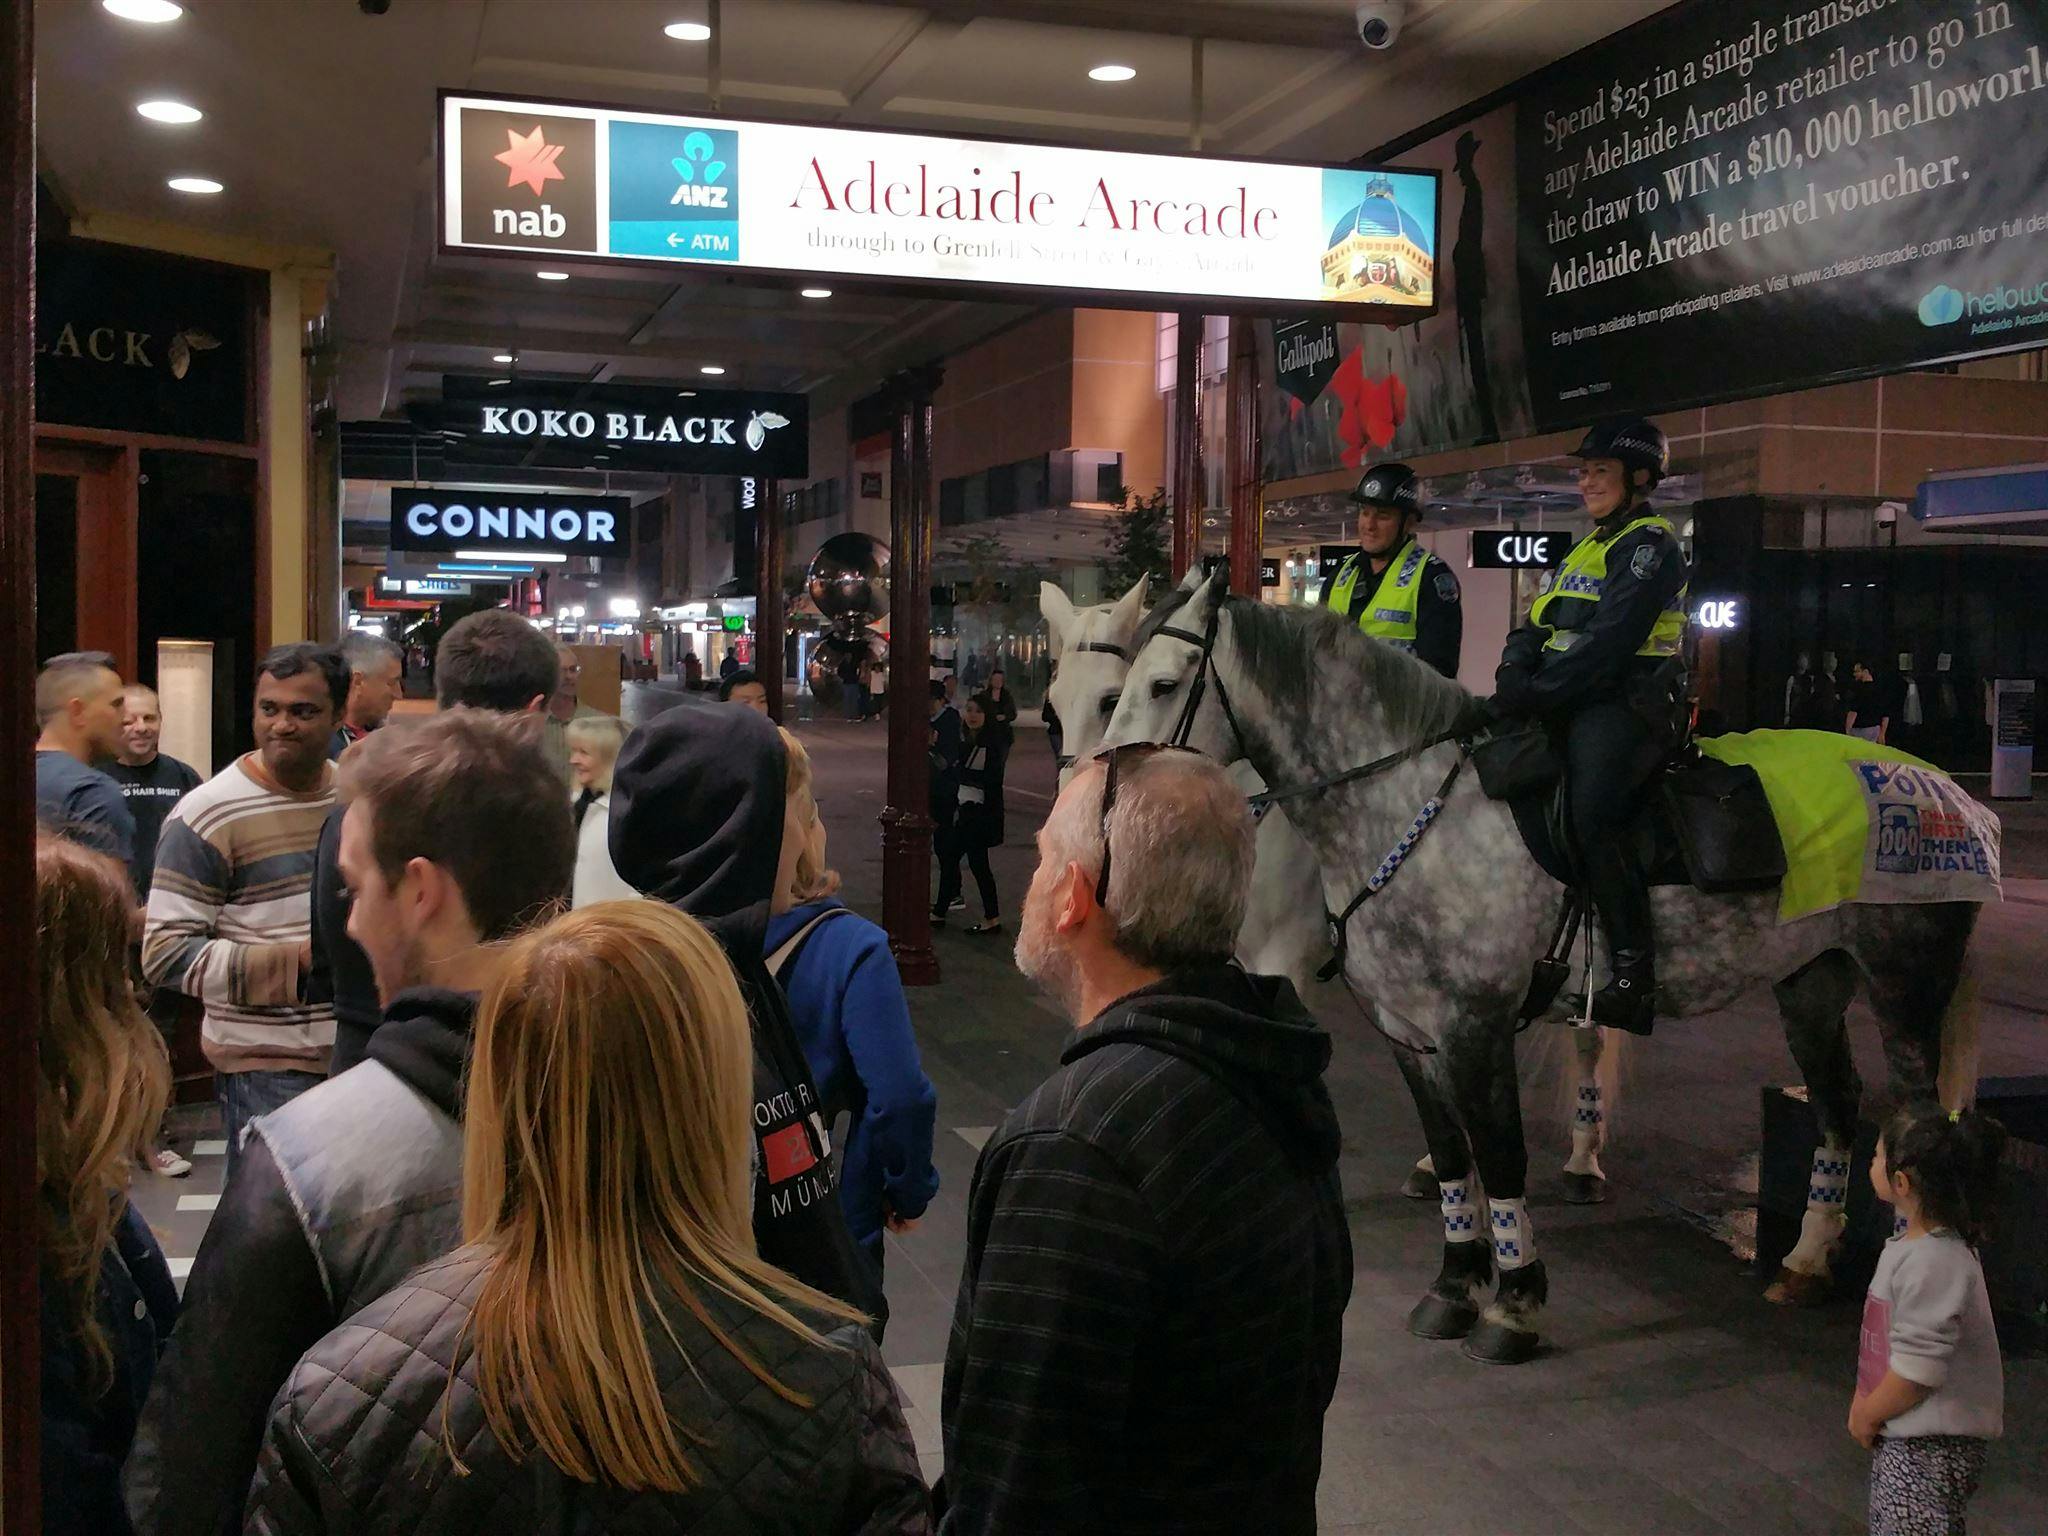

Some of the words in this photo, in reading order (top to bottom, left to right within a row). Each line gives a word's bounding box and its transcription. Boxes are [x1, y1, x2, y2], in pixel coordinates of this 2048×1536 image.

[1543, 88, 1605, 152] Spend
[1610, 78, 1650, 120] $25
[1654, 65, 1680, 100] in
[1683, 61, 1697, 87] a
[1702, 20, 1778, 77] single
[1544, 162, 1580, 199] any
[1582, 117, 1678, 181] Adelaide
[1681, 83, 1768, 144] Arcade
[1775, 46, 1880, 110] retailer
[1886, 34, 1918, 68] to
[1927, 18, 1964, 70] go
[1974, 0, 2015, 39] in
[1546, 209, 1577, 245] the
[1581, 198, 1632, 234] draw
[1636, 185, 1660, 215] to
[1662, 152, 1722, 204] WIN
[1727, 156, 1743, 185] a
[1747, 103, 1862, 179] $10,000
[1868, 45, 2048, 139] helloworl
[670, 184, 729, 209] ANZ
[789, 156, 1055, 226] Adelaide
[1078, 177, 1279, 240] Arcade
[493, 204, 567, 238] nab
[1545, 240, 1643, 297] Adelaide
[1646, 213, 1733, 268] Arcade
[1739, 183, 1820, 241] travel
[1823, 155, 1970, 212] voucher.
[691, 234, 730, 251] ATM
[807, 226, 895, 258] through
[904, 237, 925, 254] to
[1551, 329, 1574, 346] Entry
[1573, 323, 1598, 341] forms
[1598, 312, 1637, 334] available
[1637, 308, 1660, 325] from
[1659, 293, 1720, 324] participating
[1720, 282, 1764, 306] retailers.
[1766, 274, 1789, 294] Visit
[1790, 230, 1975, 287] www.adelaidearcade.com.au
[1978, 225, 1998, 244] for
[2001, 219, 2023, 239] full
[2026, 211, 2048, 233] det
[1966, 280, 2048, 318] hellowo
[1969, 318, 2013, 336] Adelaide
[1278, 325, 1335, 378] Gallipoli
[482, 406, 596, 438] KOKO
[606, 413, 737, 445] BLACK
[407, 503, 616, 542] CONNOR
[1497, 535, 1549, 563] CUE
[1699, 600, 1737, 628] CUE
[1920, 823, 1965, 839] FIRST
[1921, 838, 1971, 855] THEN
[1920, 855, 1975, 872] DIAL
